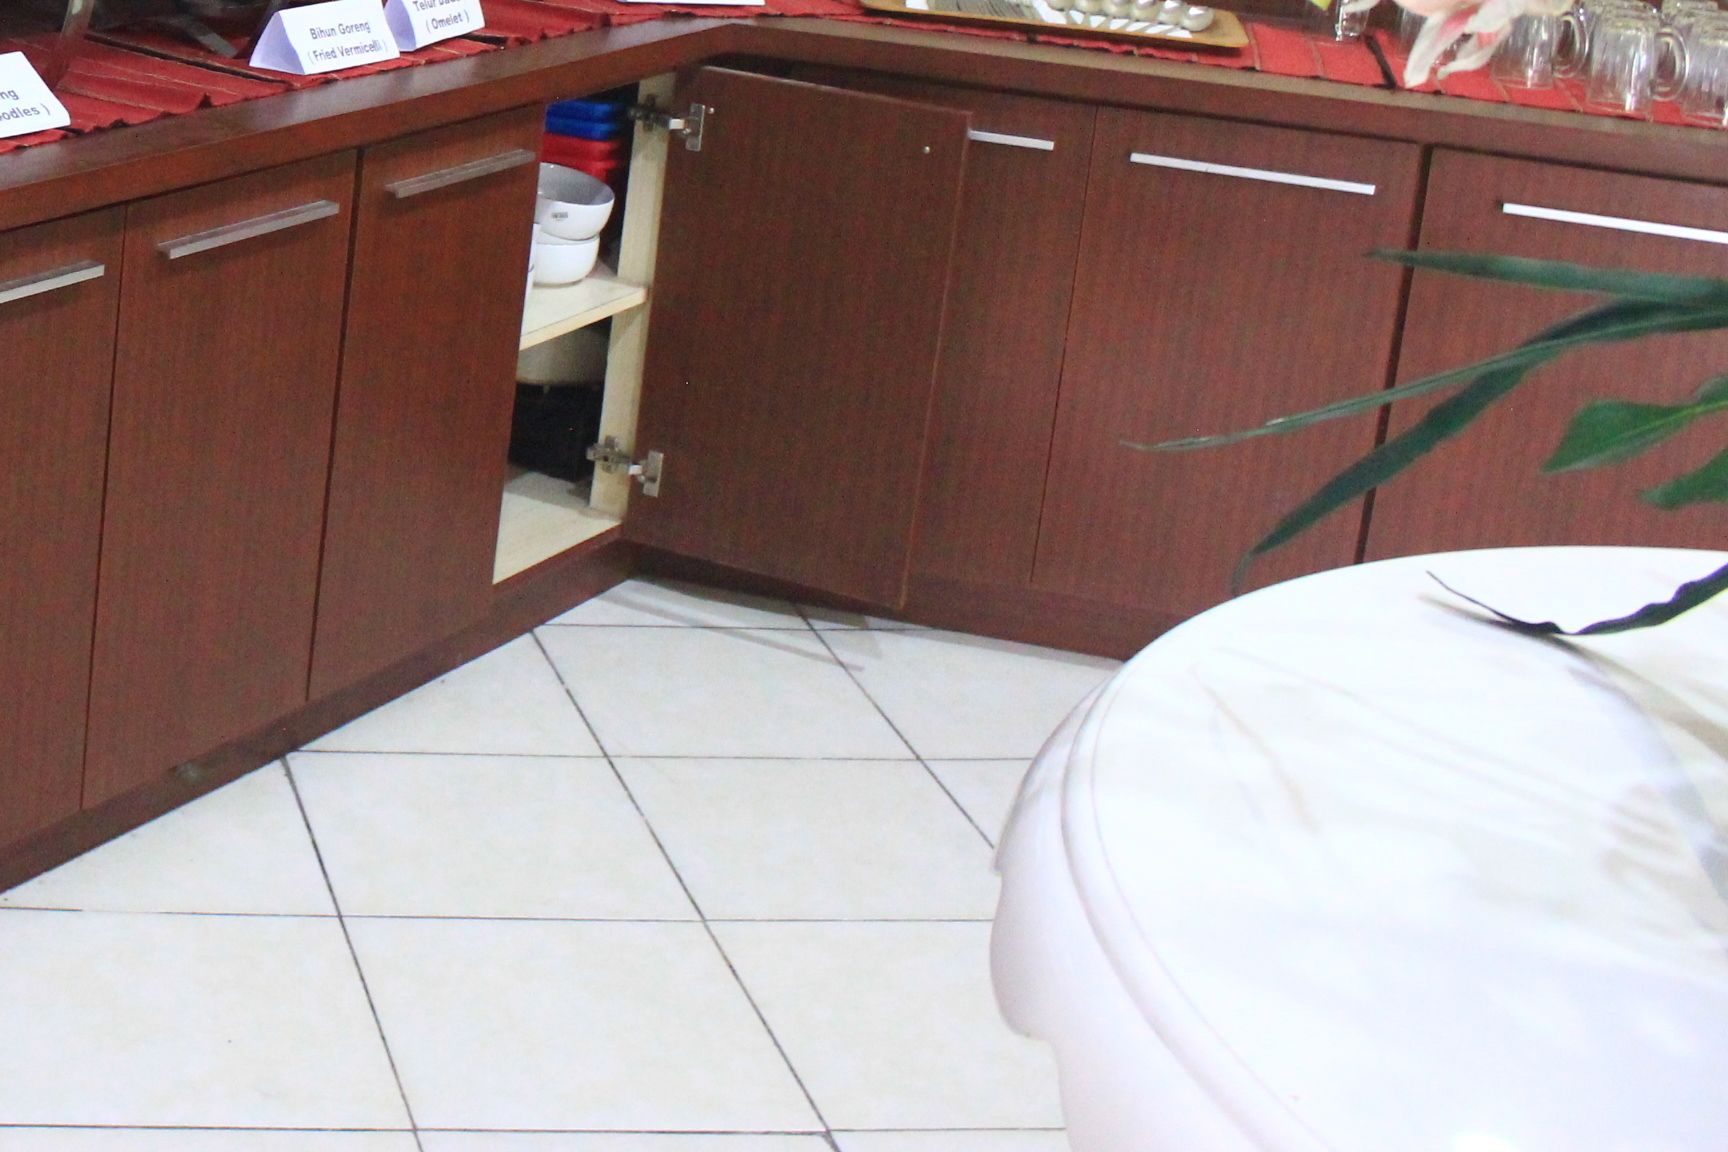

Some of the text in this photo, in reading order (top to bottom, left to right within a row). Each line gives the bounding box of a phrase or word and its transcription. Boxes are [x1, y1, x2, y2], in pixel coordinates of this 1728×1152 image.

[310, 20, 371, 40] Bihun Goreng
[313, 48, 337, 61] Fried
